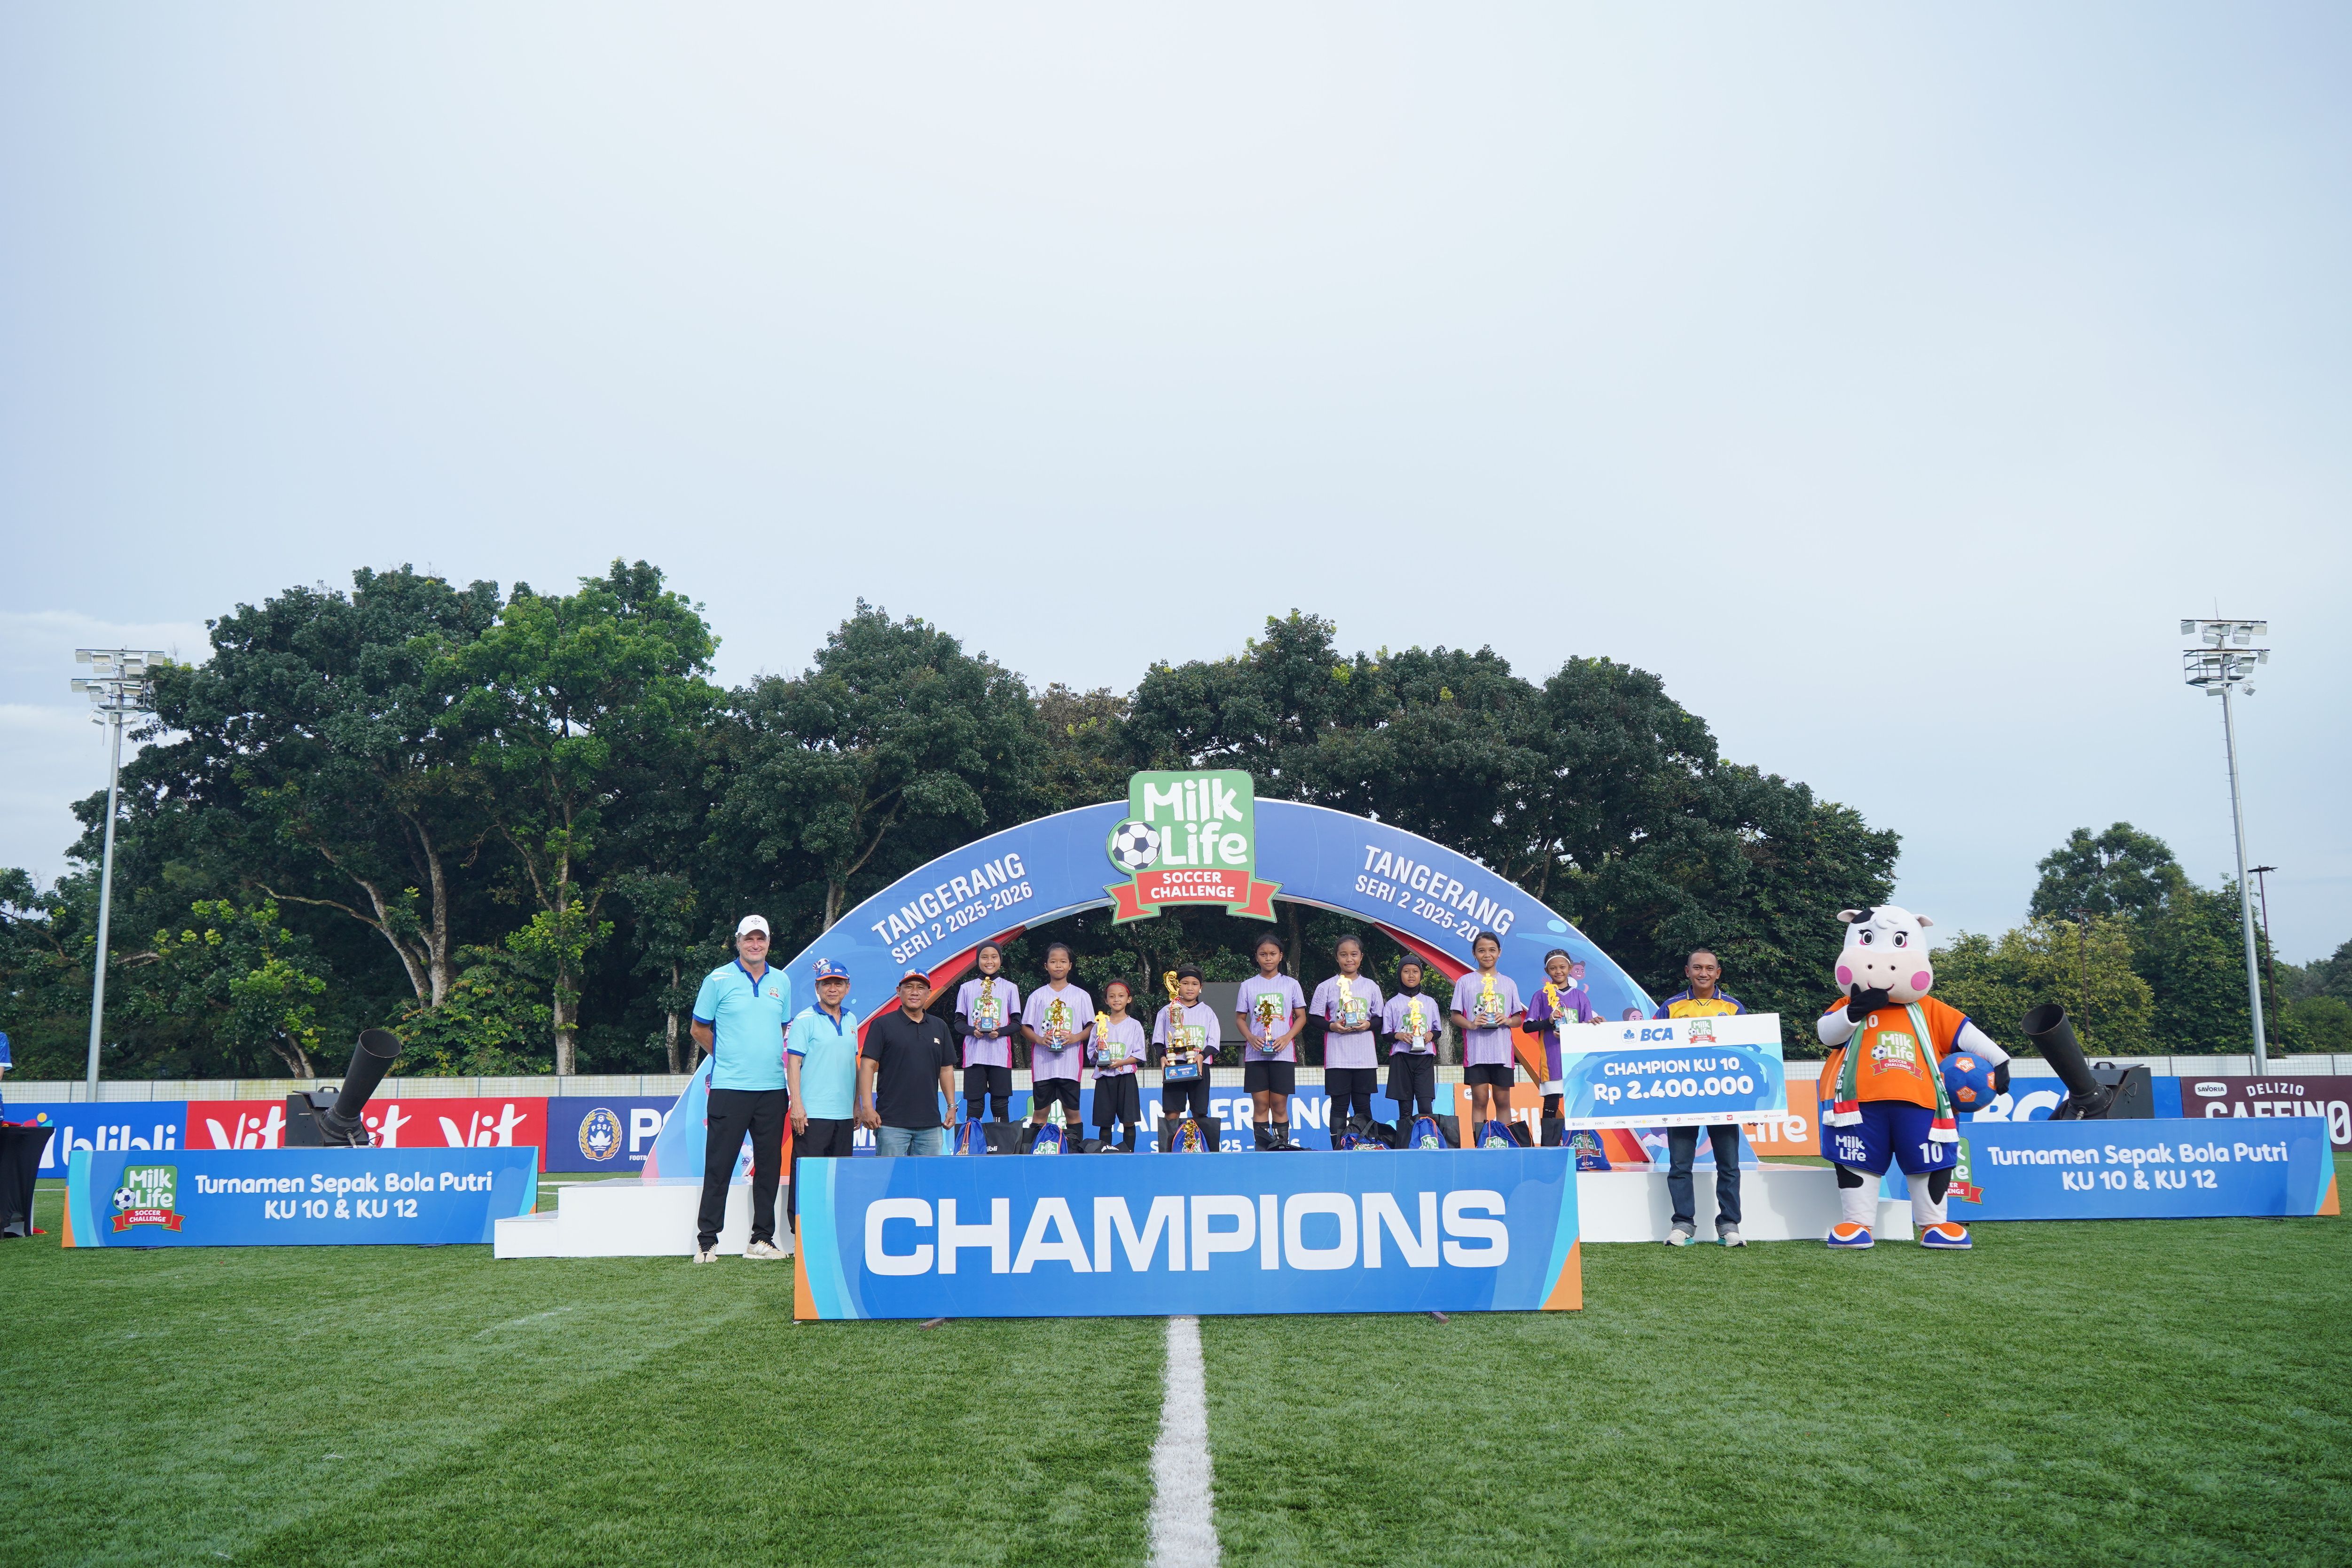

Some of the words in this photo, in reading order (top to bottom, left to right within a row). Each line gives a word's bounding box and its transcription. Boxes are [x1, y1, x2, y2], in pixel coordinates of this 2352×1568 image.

[1144, 778, 1243, 822] Milk
[1161, 822, 1247, 865] Life
[1163, 871, 1222, 884] SOCCER
[871, 853, 1025, 945] TANGERANG
[1151, 886, 1235, 899] CHALLENGE
[1364, 845, 1514, 935] TANGERANG
[1355, 874, 1396, 902] SERI
[1397, 891, 1411, 909] 2
[1412, 898, 1480, 942] 2025-20
[891, 930, 932, 965] SERI
[932, 924, 946, 941] 2
[945, 881, 1033, 933] 2025-2026
[1640, 1027, 1673, 1042] BCA
[1882, 1034, 1913, 1049] Milk
[1887, 1045, 1914, 1061] Life
[1604, 1059, 1690, 1076] CHAMPION
[1693, 1058, 1716, 1072] KU
[1720, 1057, 1740, 1070] 10
[1594, 1083, 1621, 1105] Rp
[1627, 1075, 1754, 1099] 2.400.000
[2246, 1082, 2304, 1097] DELIZIO
[206, 1106, 286, 1149] Vit
[360, 1105, 412, 1148] it
[439, 1104, 527, 1147] Vit
[591, 1123, 611, 1132] PSSI
[1835, 1135, 1865, 1150] Milk
[1919, 1142, 1943, 1163] 10
[1840, 1148, 1866, 1161] Life
[1987, 1146, 2100, 1166] Turnamen
[2105, 1143, 2175, 1169] Sepak
[2179, 1142, 2230, 1163] Bola
[2234, 1142, 2289, 1162] Putri
[129, 1168, 172, 1189] Milk
[195, 1175, 304, 1193] Turnamen
[310, 1172, 379, 1198] Sepak
[385, 1172, 434, 1192] Bola
[439, 1171, 492, 1191] Putri
[2062, 1171, 2094, 1192] KU
[2099, 1171, 2126, 1190] 10
[2133, 1170, 2150, 1191] &
[2155, 1170, 2187, 1190] KU
[2191, 1169, 2218, 1189] 12
[135, 1188, 173, 1207] Life
[265, 1200, 297, 1220] KU
[301, 1200, 328, 1218] 10
[334, 1199, 350, 1219] &
[356, 1199, 388, 1218] KU
[393, 1199, 418, 1218] 12
[865, 1190, 1509, 1276] CHAMPIONS
